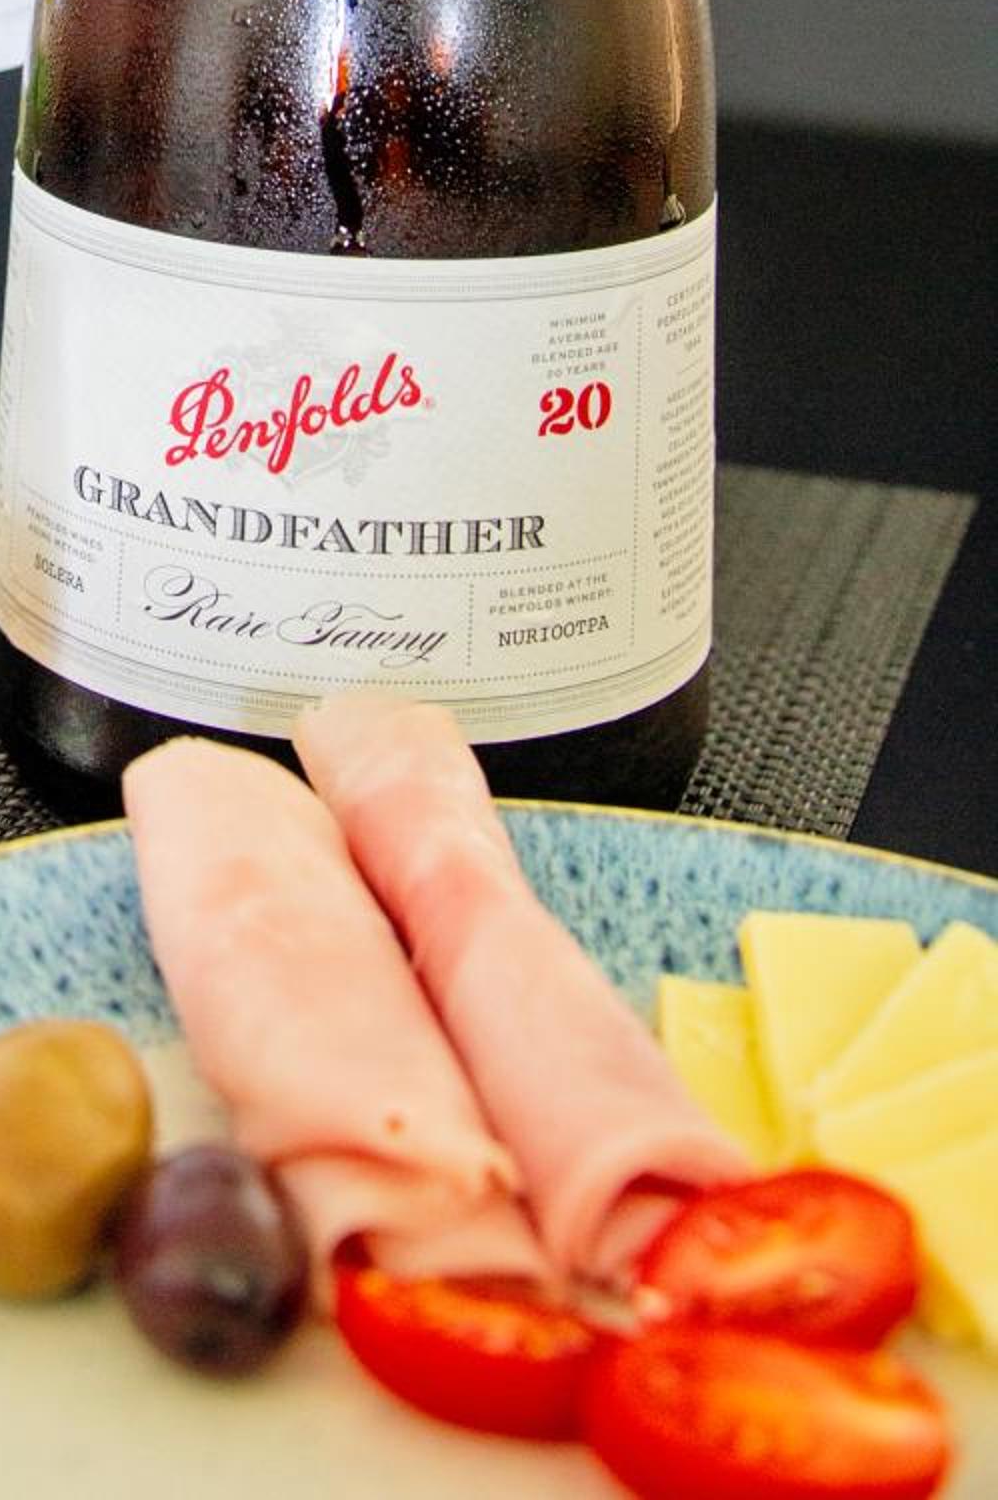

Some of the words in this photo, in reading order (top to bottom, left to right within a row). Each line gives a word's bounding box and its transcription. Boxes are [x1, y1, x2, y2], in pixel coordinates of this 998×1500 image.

[548, 329, 606, 345] AVERAGE
[165, 352, 422, 474] Penfolds
[538, 381, 613, 437] 20
[73, 464, 547, 556] GRANDFATHER
[34, 552, 84, 592] SOLERA
[499, 581, 564, 599] BLENDED
[585, 573, 608, 587] THE
[143, 564, 271, 639] Rare
[277, 600, 447, 669] Tawny
[498, 614, 610, 648] NURIOOTPA
